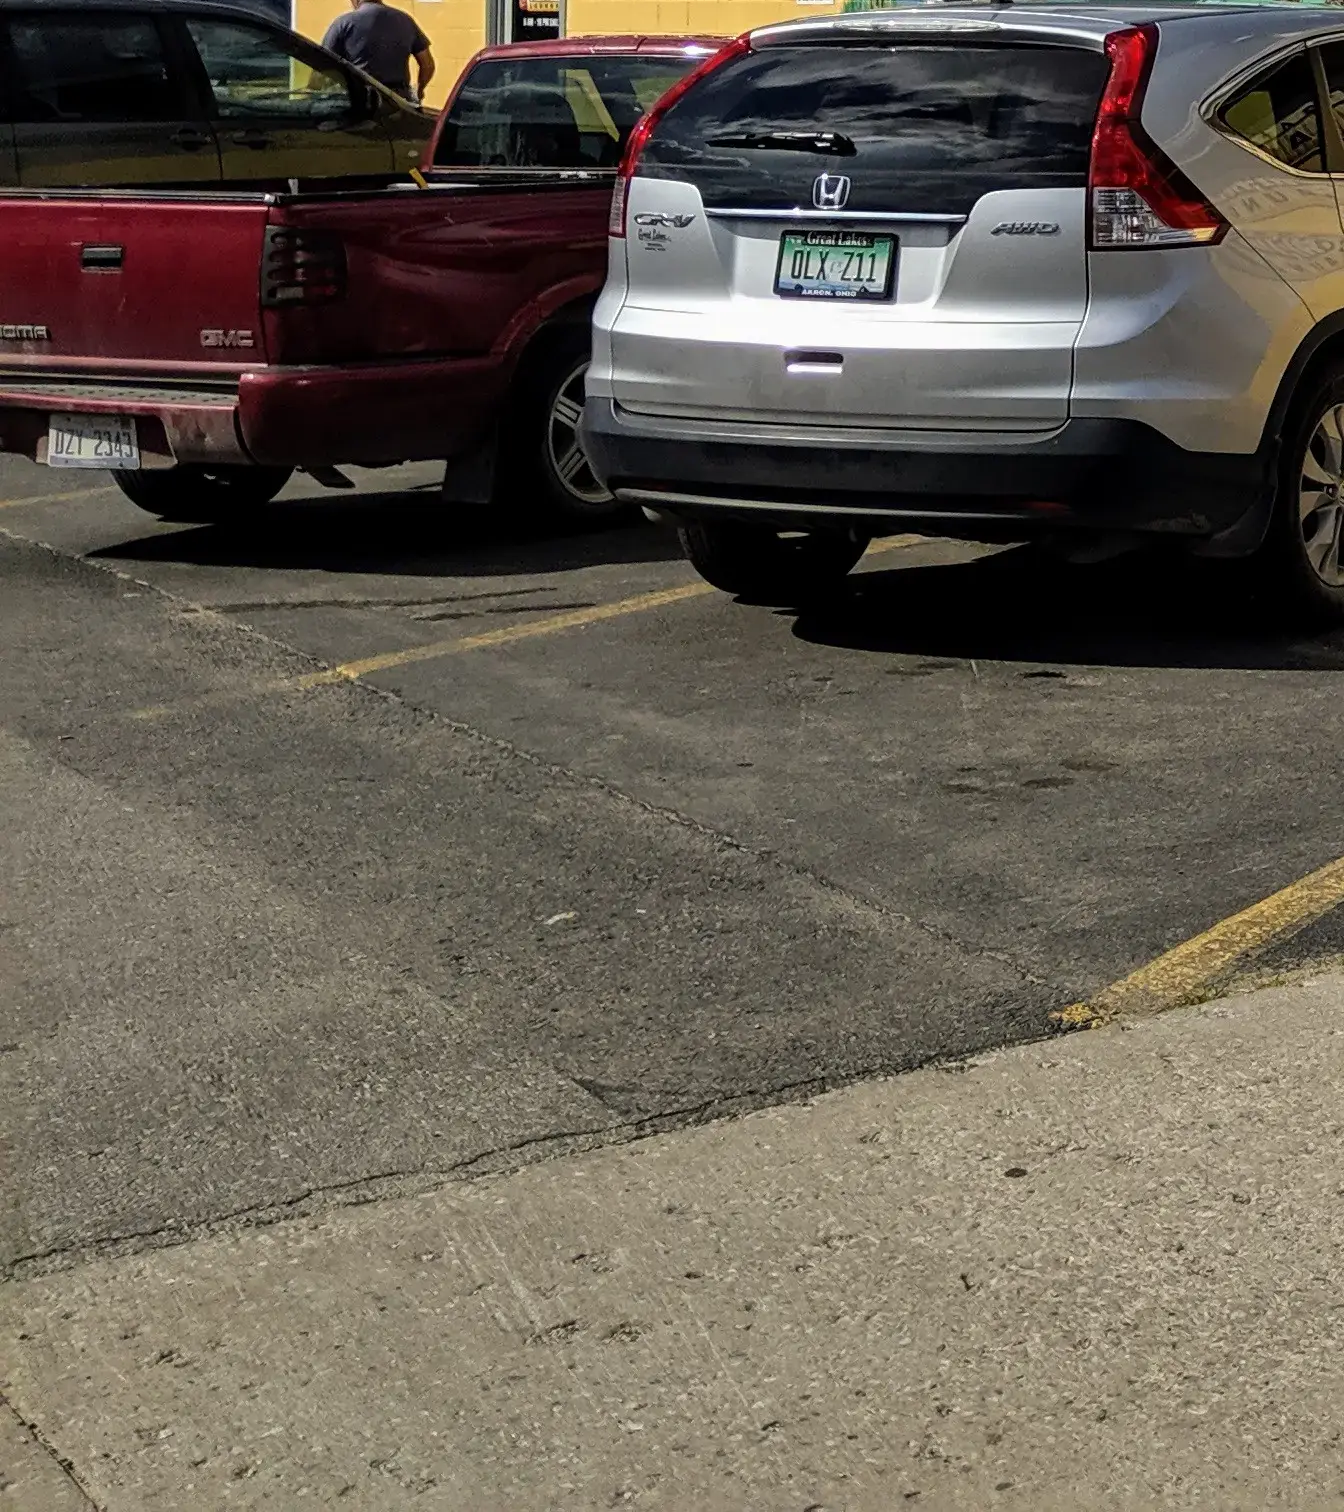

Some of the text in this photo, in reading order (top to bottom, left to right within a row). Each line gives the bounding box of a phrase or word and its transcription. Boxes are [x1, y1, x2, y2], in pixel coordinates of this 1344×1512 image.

[990, 221, 1061, 236] AWD
[806, 230, 869, 247] Great Lakes
[200, 329, 254, 348] GMC
